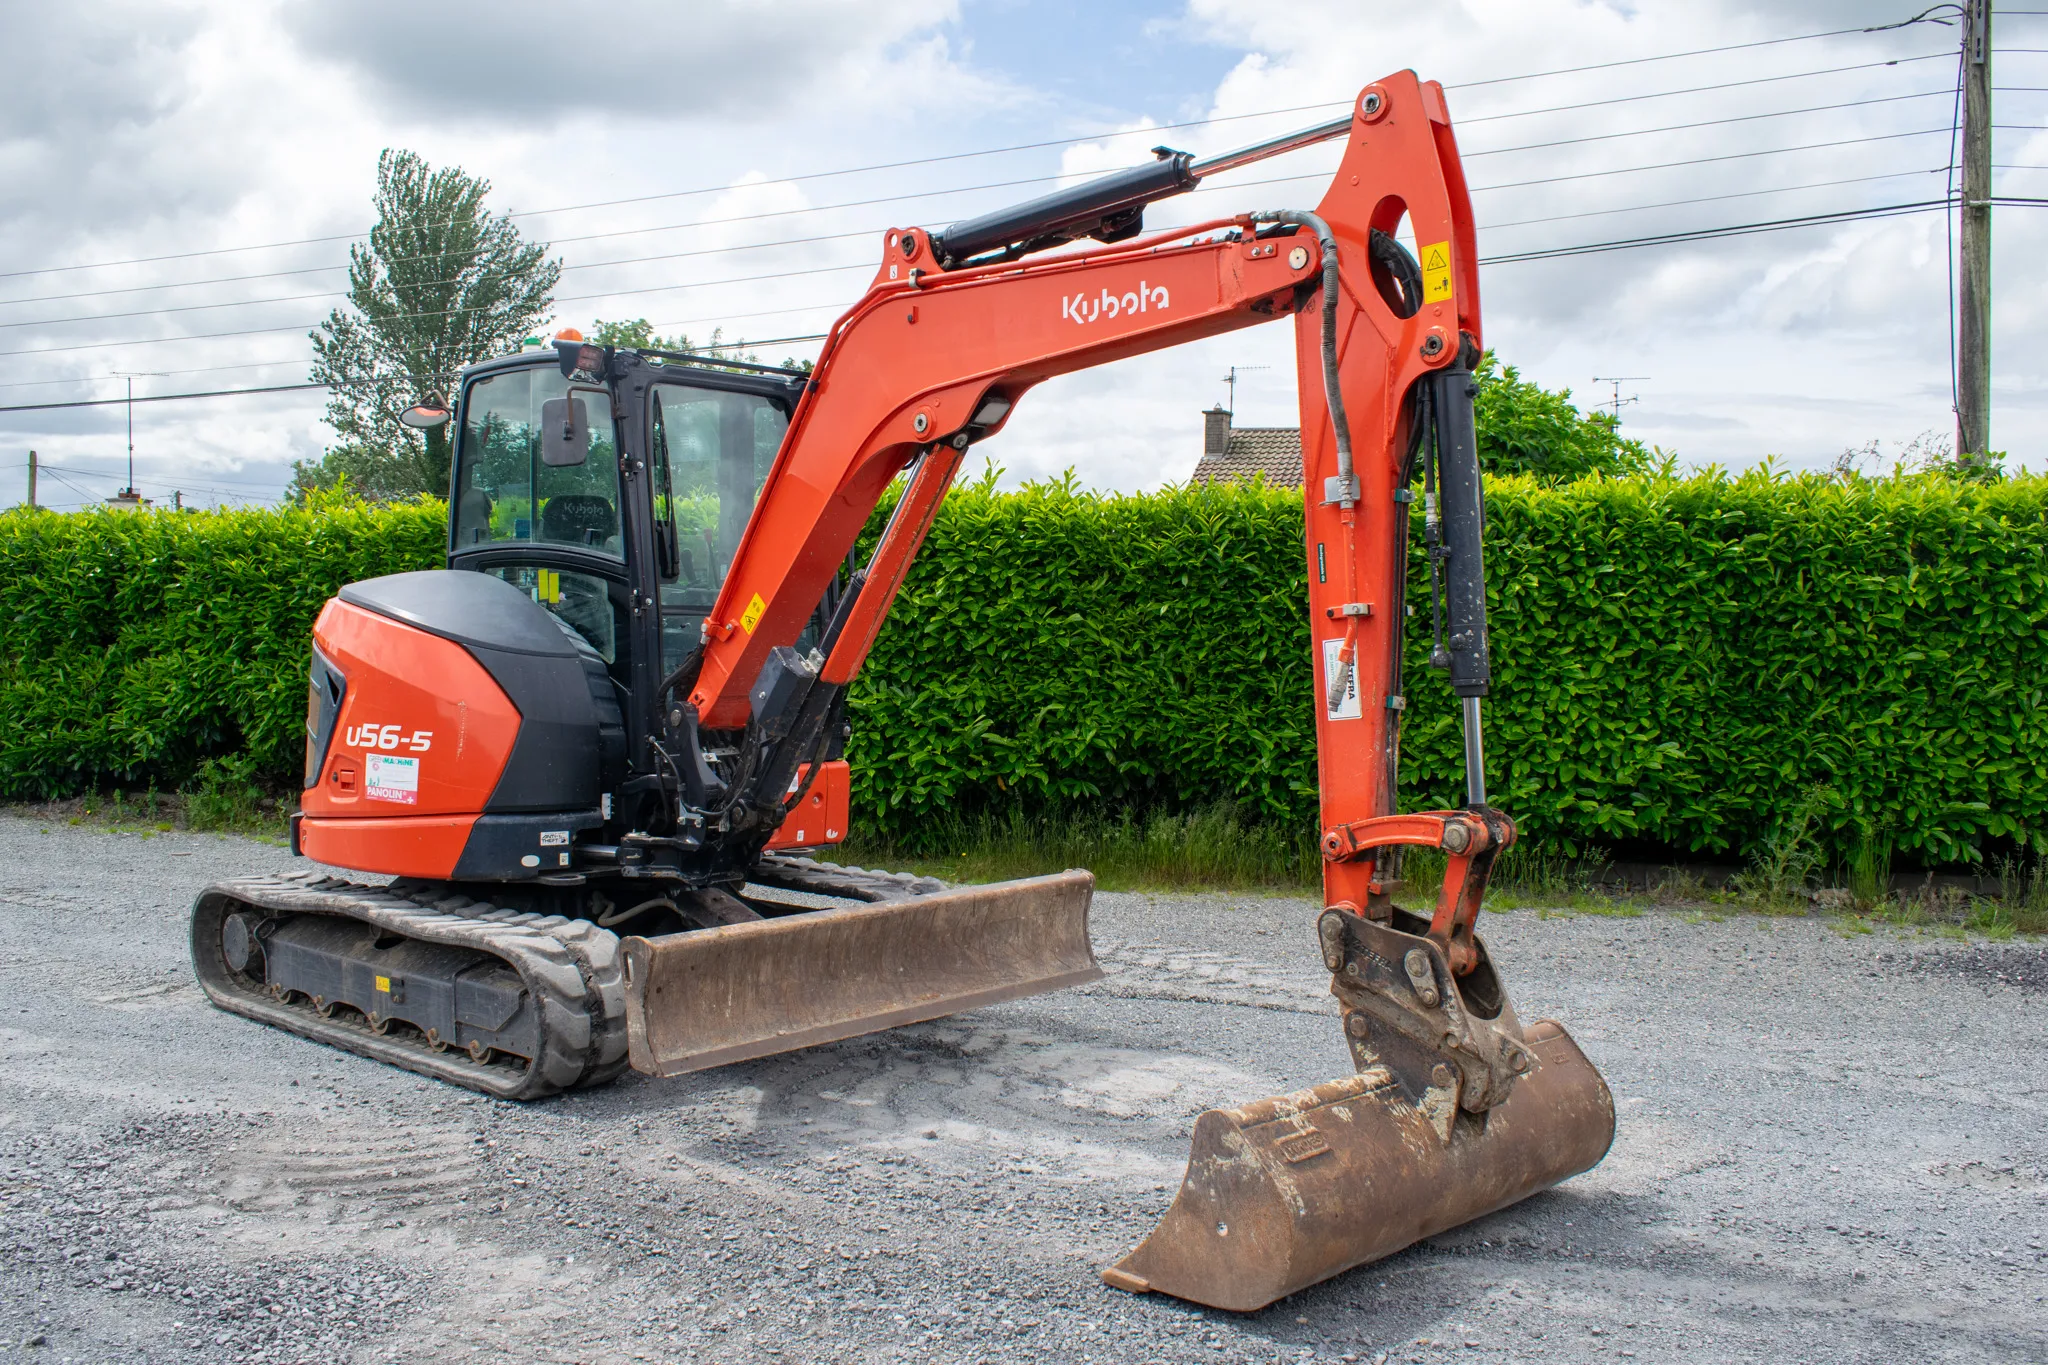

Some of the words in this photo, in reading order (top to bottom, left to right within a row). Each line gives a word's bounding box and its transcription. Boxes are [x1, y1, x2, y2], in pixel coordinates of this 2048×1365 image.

[1062, 280, 1169, 325] Kubota
[564, 502, 604, 515] Kubota
[1347, 667, 1356, 700] TEFRA
[346, 722, 434, 752] U56-5
[367, 786, 403, 800] PANOLIN
